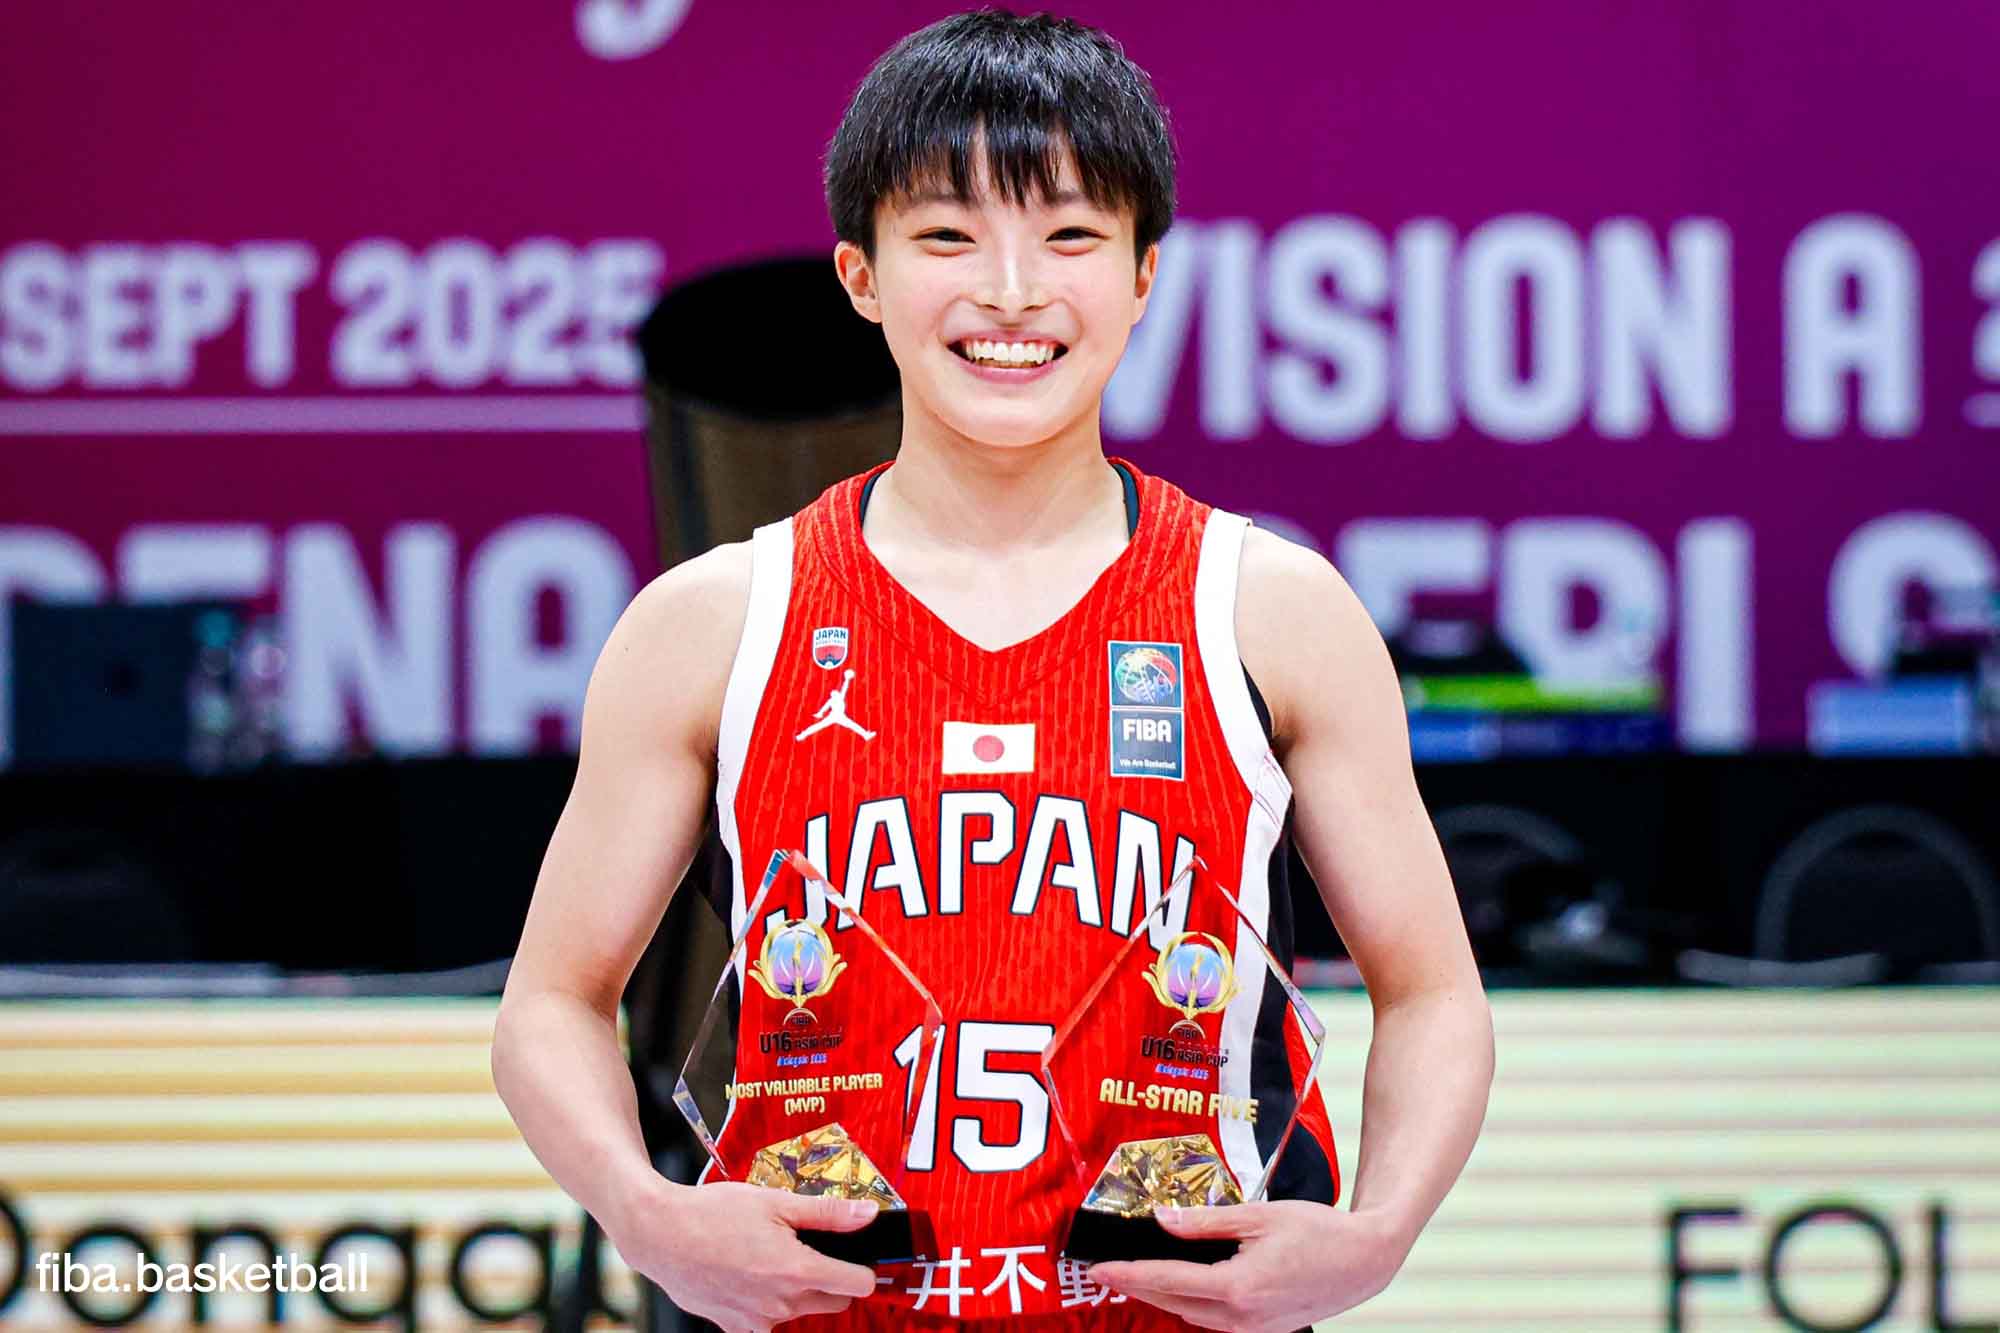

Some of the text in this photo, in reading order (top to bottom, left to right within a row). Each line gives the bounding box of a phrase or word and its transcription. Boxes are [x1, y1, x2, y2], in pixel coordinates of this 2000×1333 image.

[0, 237, 664, 392] SEPT 2025
[1783, 212, 1923, 440] A
[816, 629, 847, 640] JAPAN
[1123, 718, 1172, 743] FIBA
[764, 790, 1197, 953] JAPAN
[759, 1032, 792, 1054] U16
[1140, 1036, 1175, 1060] U16
[725, 1073, 883, 1100] MOST VALUABLE PLAYER
[893, 1020, 1056, 1173] 15
[1100, 1077, 1203, 1116] ALL-STAR
[784, 1095, 826, 1117] (MVP)
